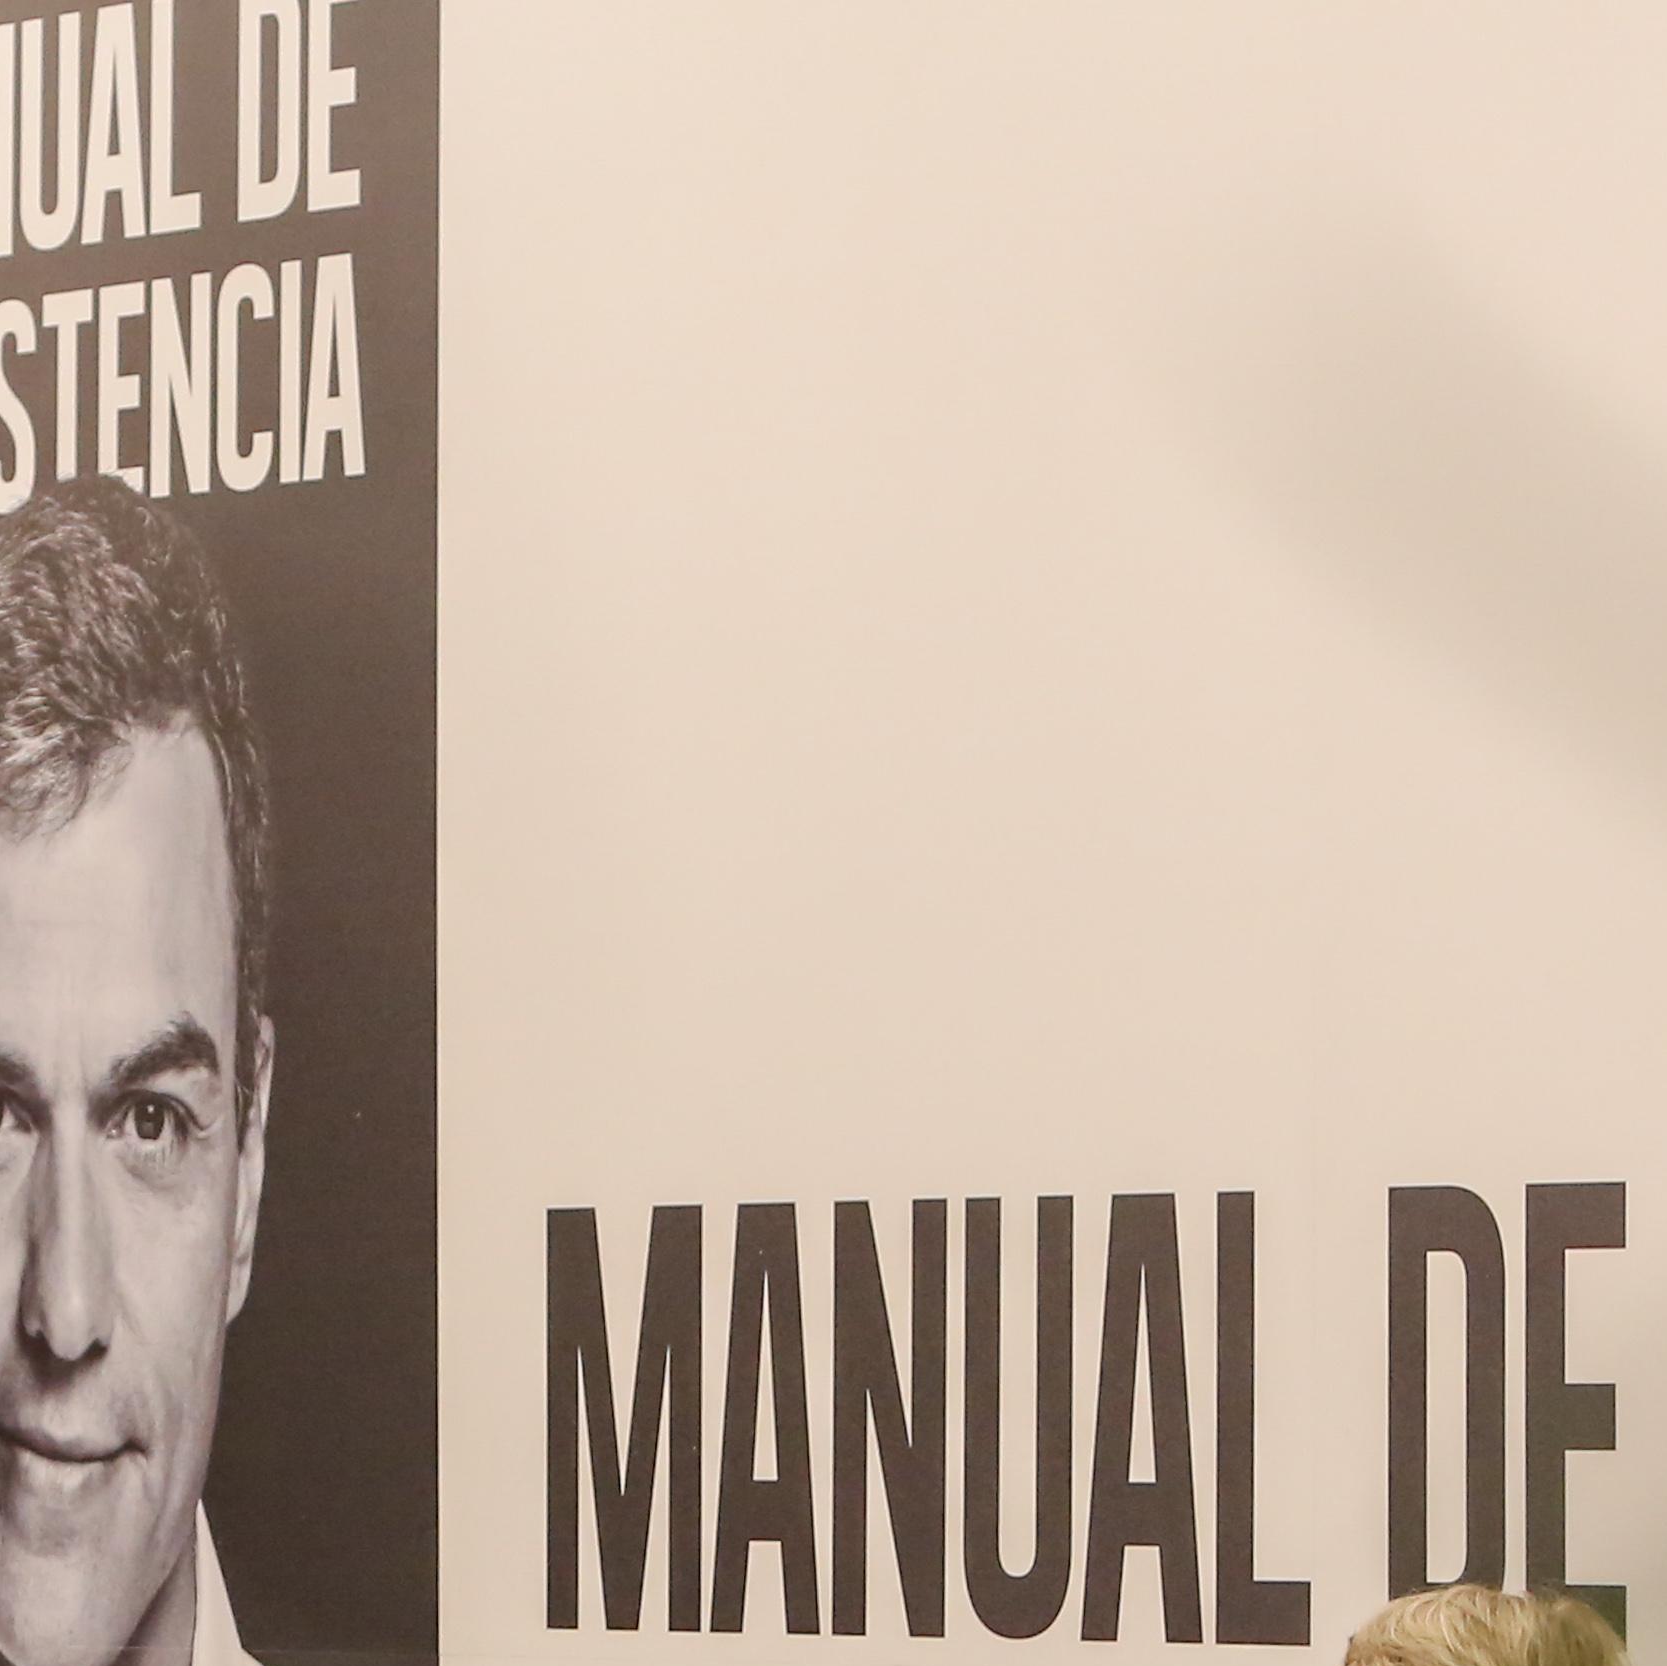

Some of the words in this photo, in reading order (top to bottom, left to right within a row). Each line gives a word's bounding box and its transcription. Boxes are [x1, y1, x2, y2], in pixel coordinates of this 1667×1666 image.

[237, 0, 362, 223] DE
[545, 1190, 1312, 1647] MANUAL
[1386, 1180, 1628, 1651] DE
